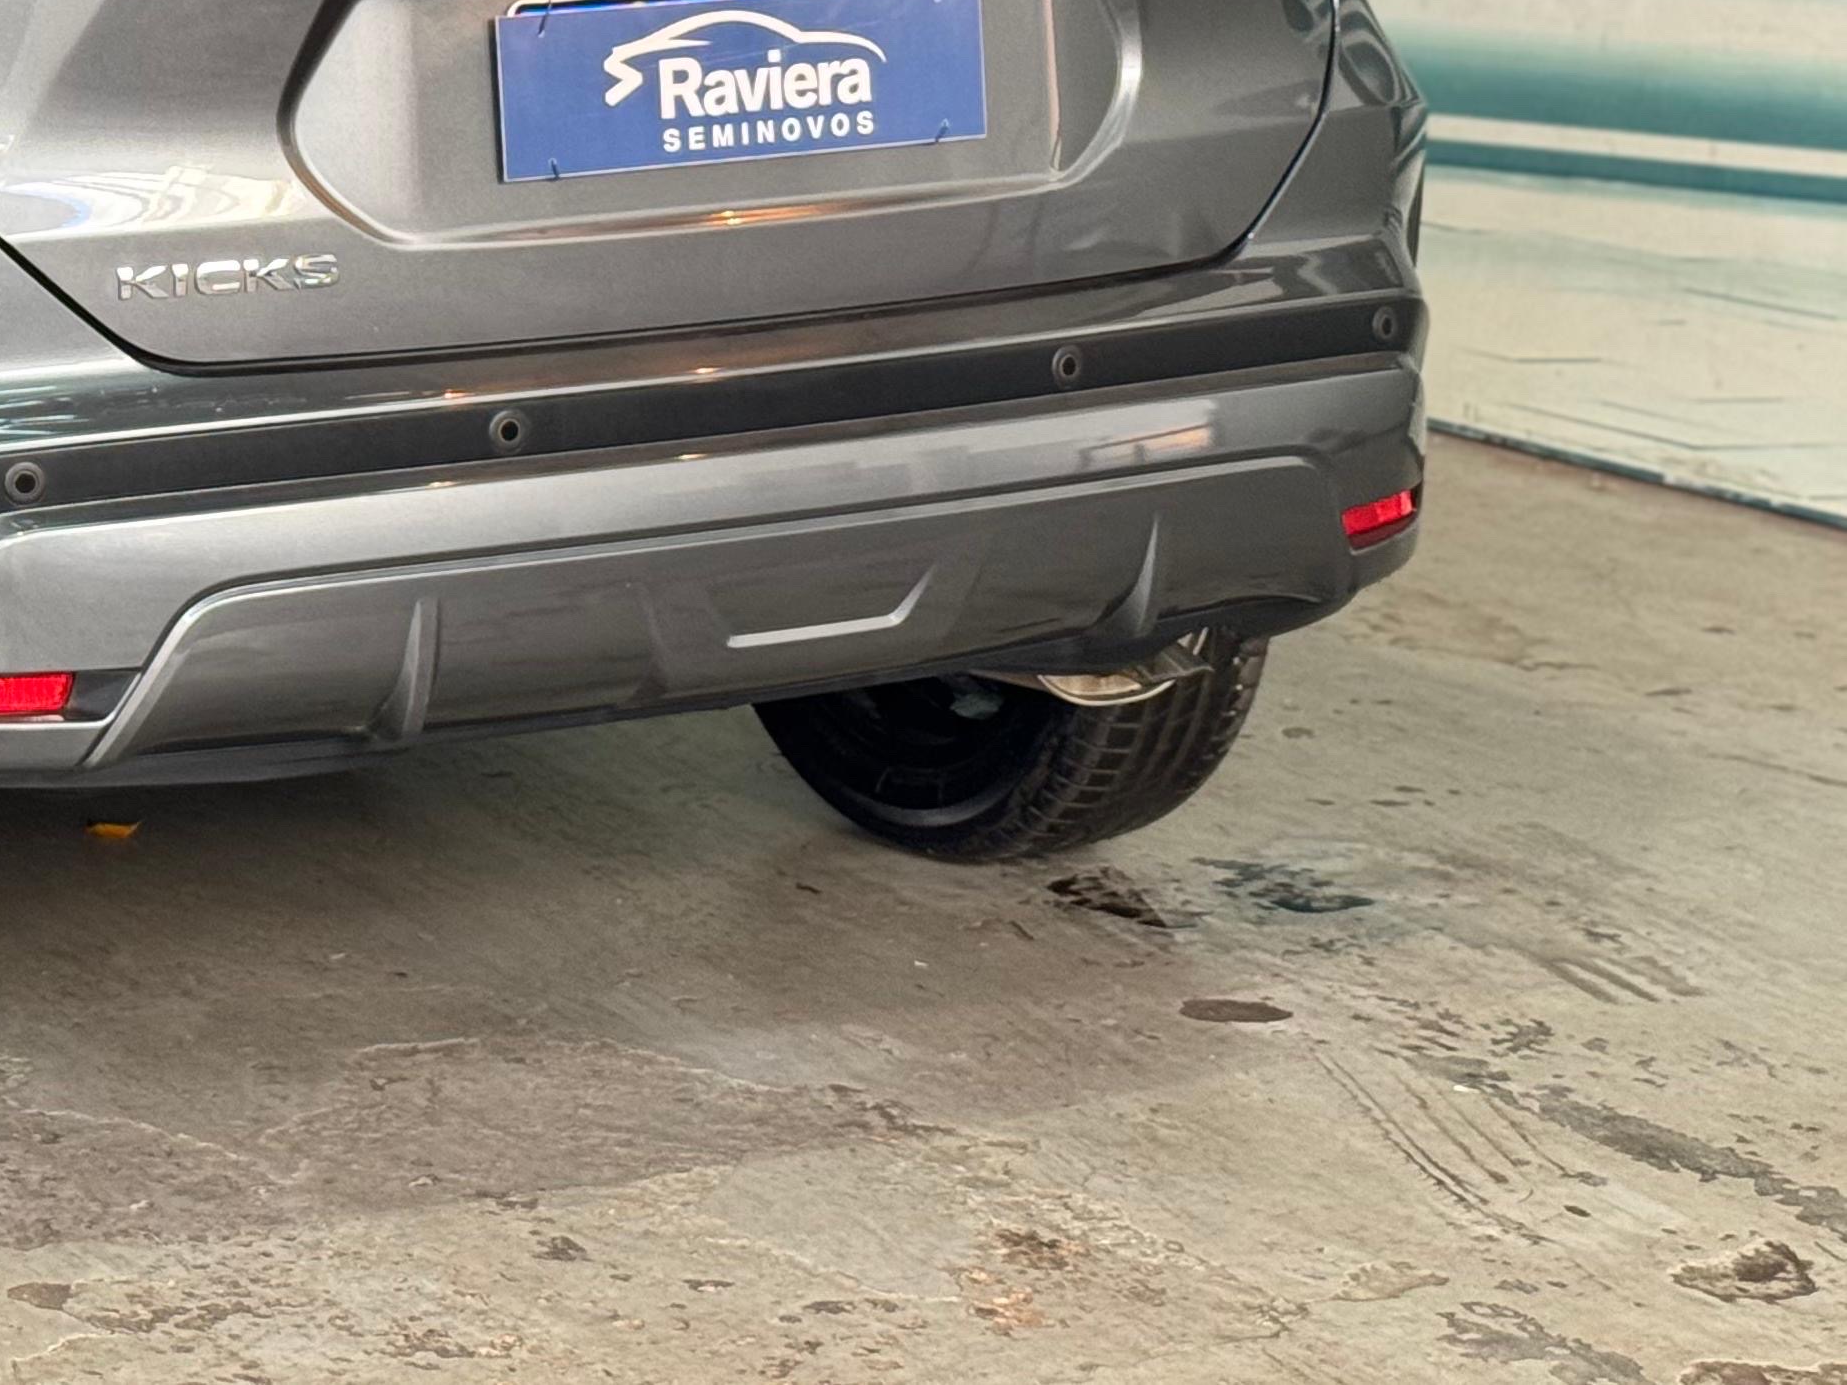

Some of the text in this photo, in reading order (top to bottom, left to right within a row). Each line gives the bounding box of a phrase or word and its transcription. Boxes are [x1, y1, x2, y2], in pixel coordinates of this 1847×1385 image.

[658, 48, 874, 120] Raviera
[663, 110, 875, 153] SEMINOVOS
[116, 254, 340, 301] KICKS
